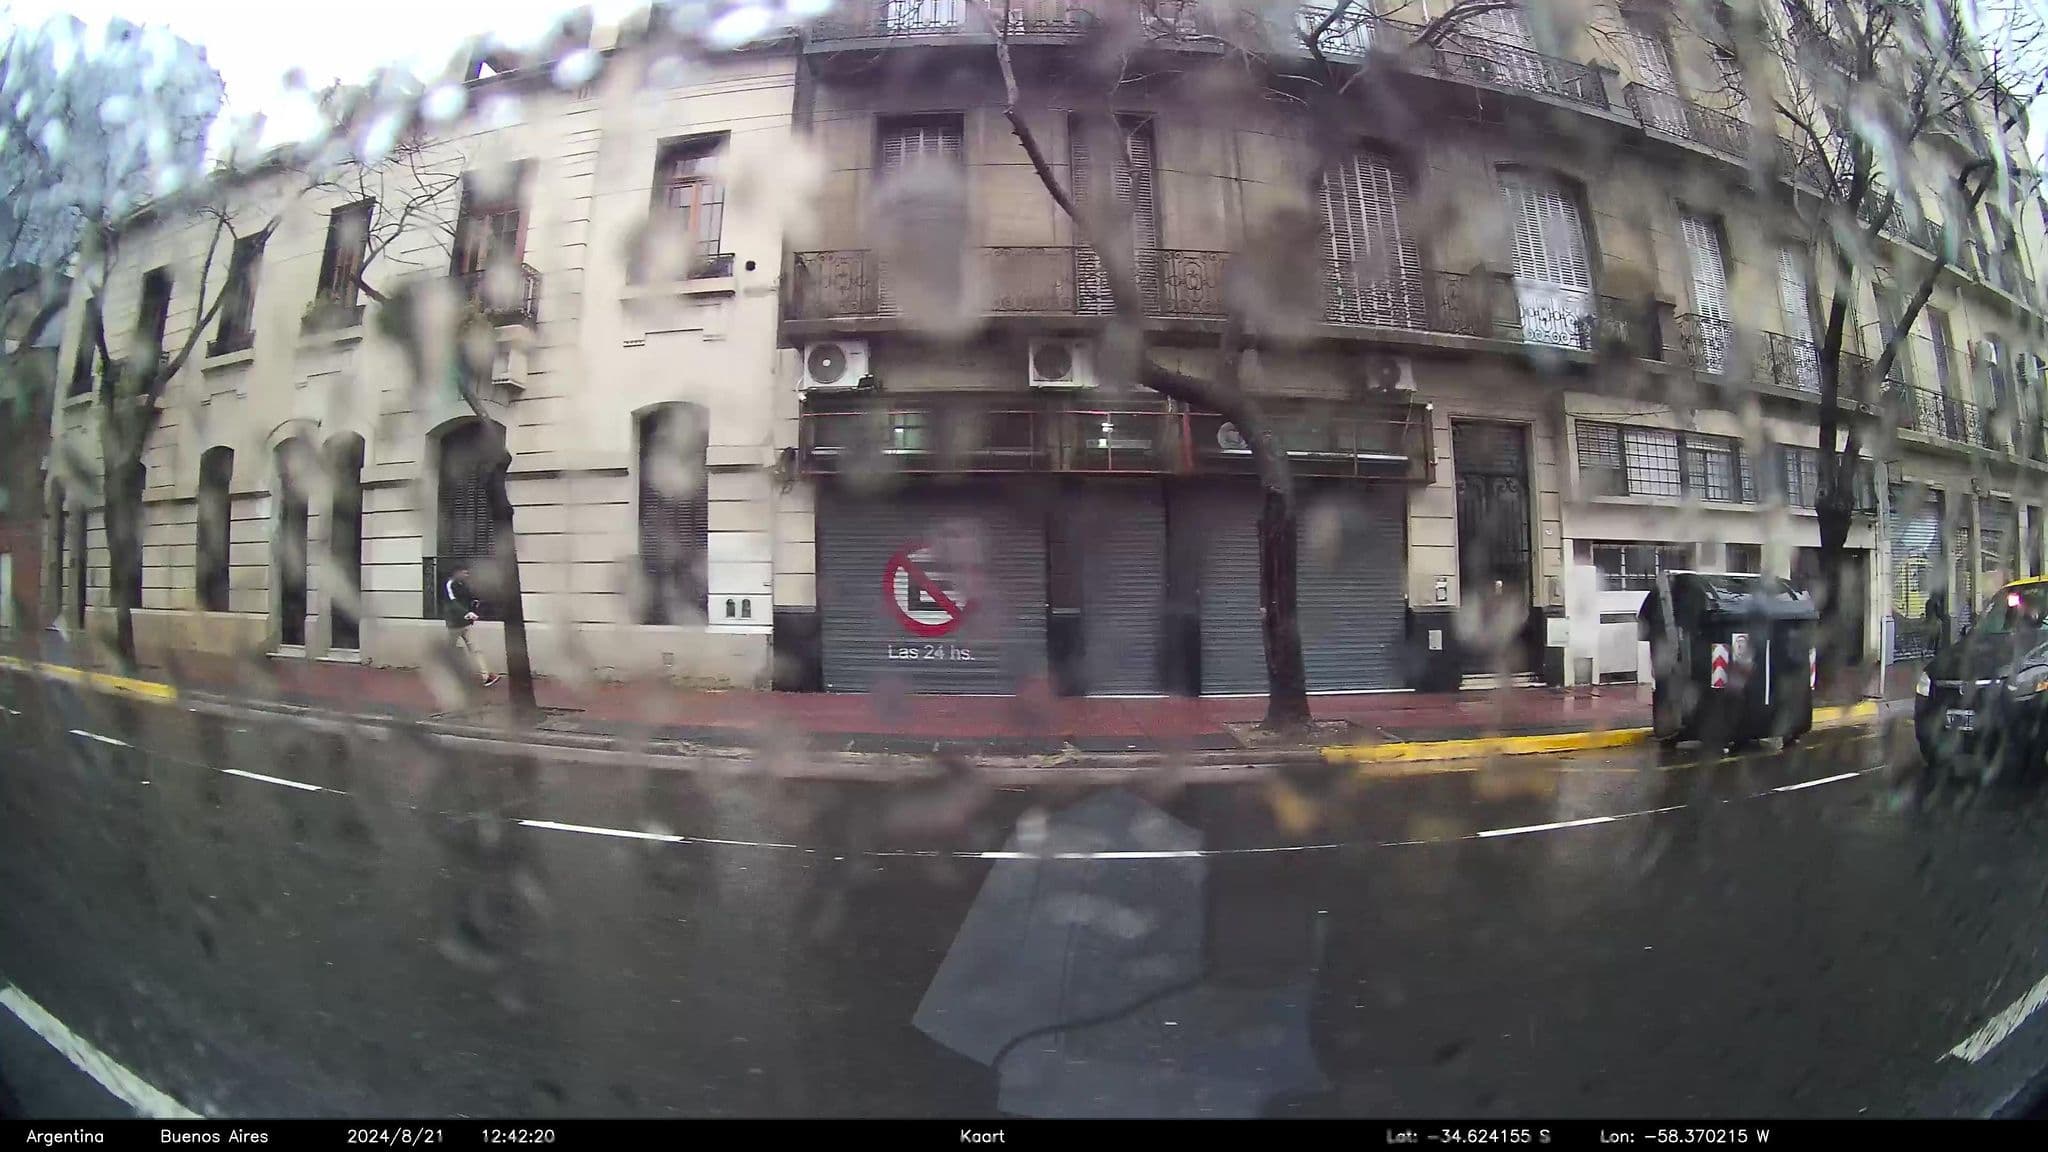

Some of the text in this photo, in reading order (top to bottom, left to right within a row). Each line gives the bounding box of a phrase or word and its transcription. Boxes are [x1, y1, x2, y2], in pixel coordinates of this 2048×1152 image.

[887, 644, 975, 661] Las 24 hs.
